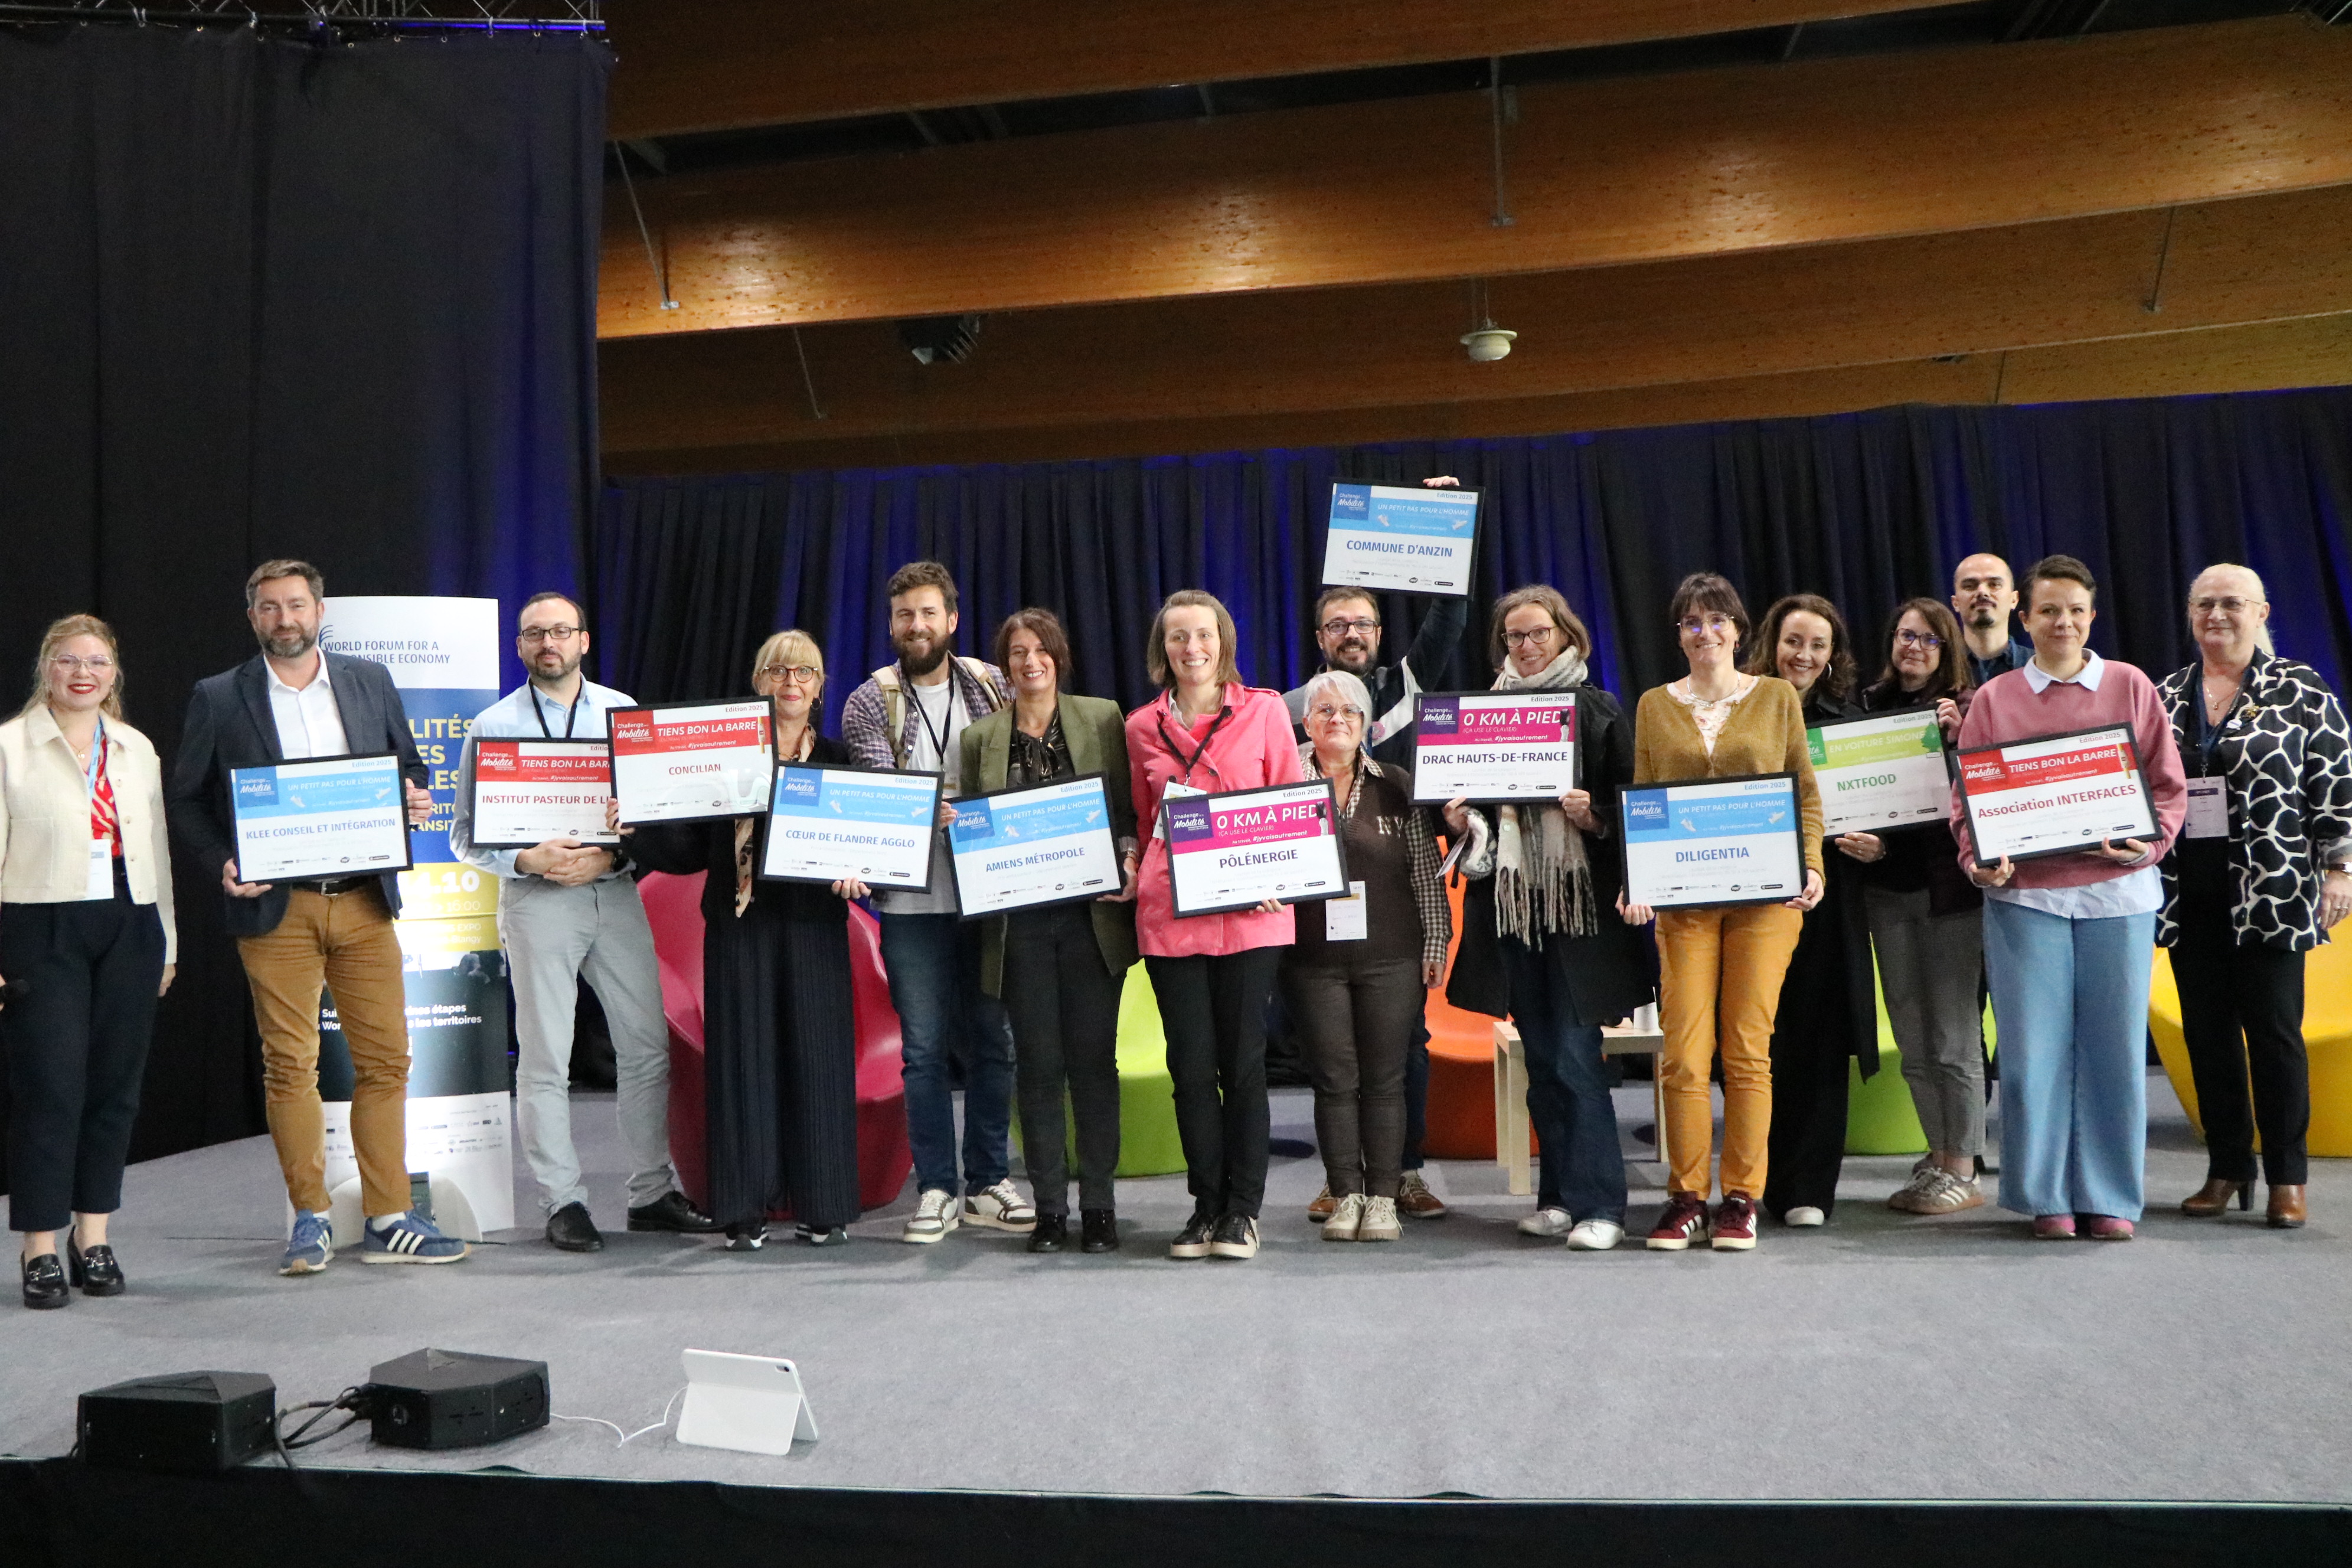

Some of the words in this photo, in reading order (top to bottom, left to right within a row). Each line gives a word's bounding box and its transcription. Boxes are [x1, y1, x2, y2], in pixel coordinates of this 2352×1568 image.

[1347, 540, 1404, 554] COMMUNE
[1407, 545, 1452, 557] D'ANZIN
[325, 642, 361, 651] WORLD
[365, 641, 404, 651] FORUM
[408, 641, 425, 650] FOR
[432, 642, 439, 650] A
[398, 654, 450, 664] ECONOMY
[1479, 713, 1506, 725] KM
[1509, 708, 1521, 724] À
[1527, 711, 1561, 724] PIED
[617, 729, 649, 739] Mobilité
[658, 727, 684, 736] TIENS
[687, 725, 708, 734] BON
[711, 724, 723, 733] LA
[726, 722, 756, 731] BARRE
[1845, 740, 1883, 750] VOITURE
[1423, 755, 1453, 765] DRAC
[1457, 752, 1567, 763] HAUTS-DE-FRANCE
[2009, 762, 2039, 773] TIENS
[2041, 757, 2064, 768] BON
[2067, 755, 2081, 765] LA
[2083, 749, 2116, 761] BARRE
[669, 764, 721, 775] CONCILIAN
[1966, 768, 2001, 779] Mobilité
[358, 776, 391, 785] L'HOMME
[1837, 774, 1896, 791] NXTFOOD
[240, 784, 271, 793] Mobilité
[785, 783, 815, 792] Mobilité
[1061, 785, 1083, 793] Edition
[897, 794, 929, 802] L'HOMME
[1979, 799, 2053, 818] Association
[2057, 784, 2136, 805] INTERFACES
[1013, 811, 1031, 819] PETIT
[1067, 799, 1100, 809] L'HOMME
[1631, 806, 1661, 816] Mobilité
[958, 816, 986, 827] Mobilité
[1234, 812, 1260, 827] KM
[1265, 806, 1277, 824] À
[1282, 805, 1317, 821] PIED
[247, 830, 270, 839] KLEE
[273, 828, 315, 837] CONSEIL
[331, 818, 395, 831] INTÉGRATION
[1174, 819, 1204, 829] Mobilité
[786, 830, 815, 840] CŒUR
[834, 834, 878, 844] FLANDRE
[881, 838, 914, 847] AGGLO
[1253, 831, 1308, 841] #jyvaisautrement
[986, 858, 1023, 872] AMIENS
[1025, 847, 1084, 864] MÉTROPOLE
[1220, 850, 1298, 868] PÔLÉNERGIE
[1676, 847, 1749, 863] DILIGENTIA
[433, 1004, 466, 1016] étapes
[433, 1015, 482, 1026] territoires
